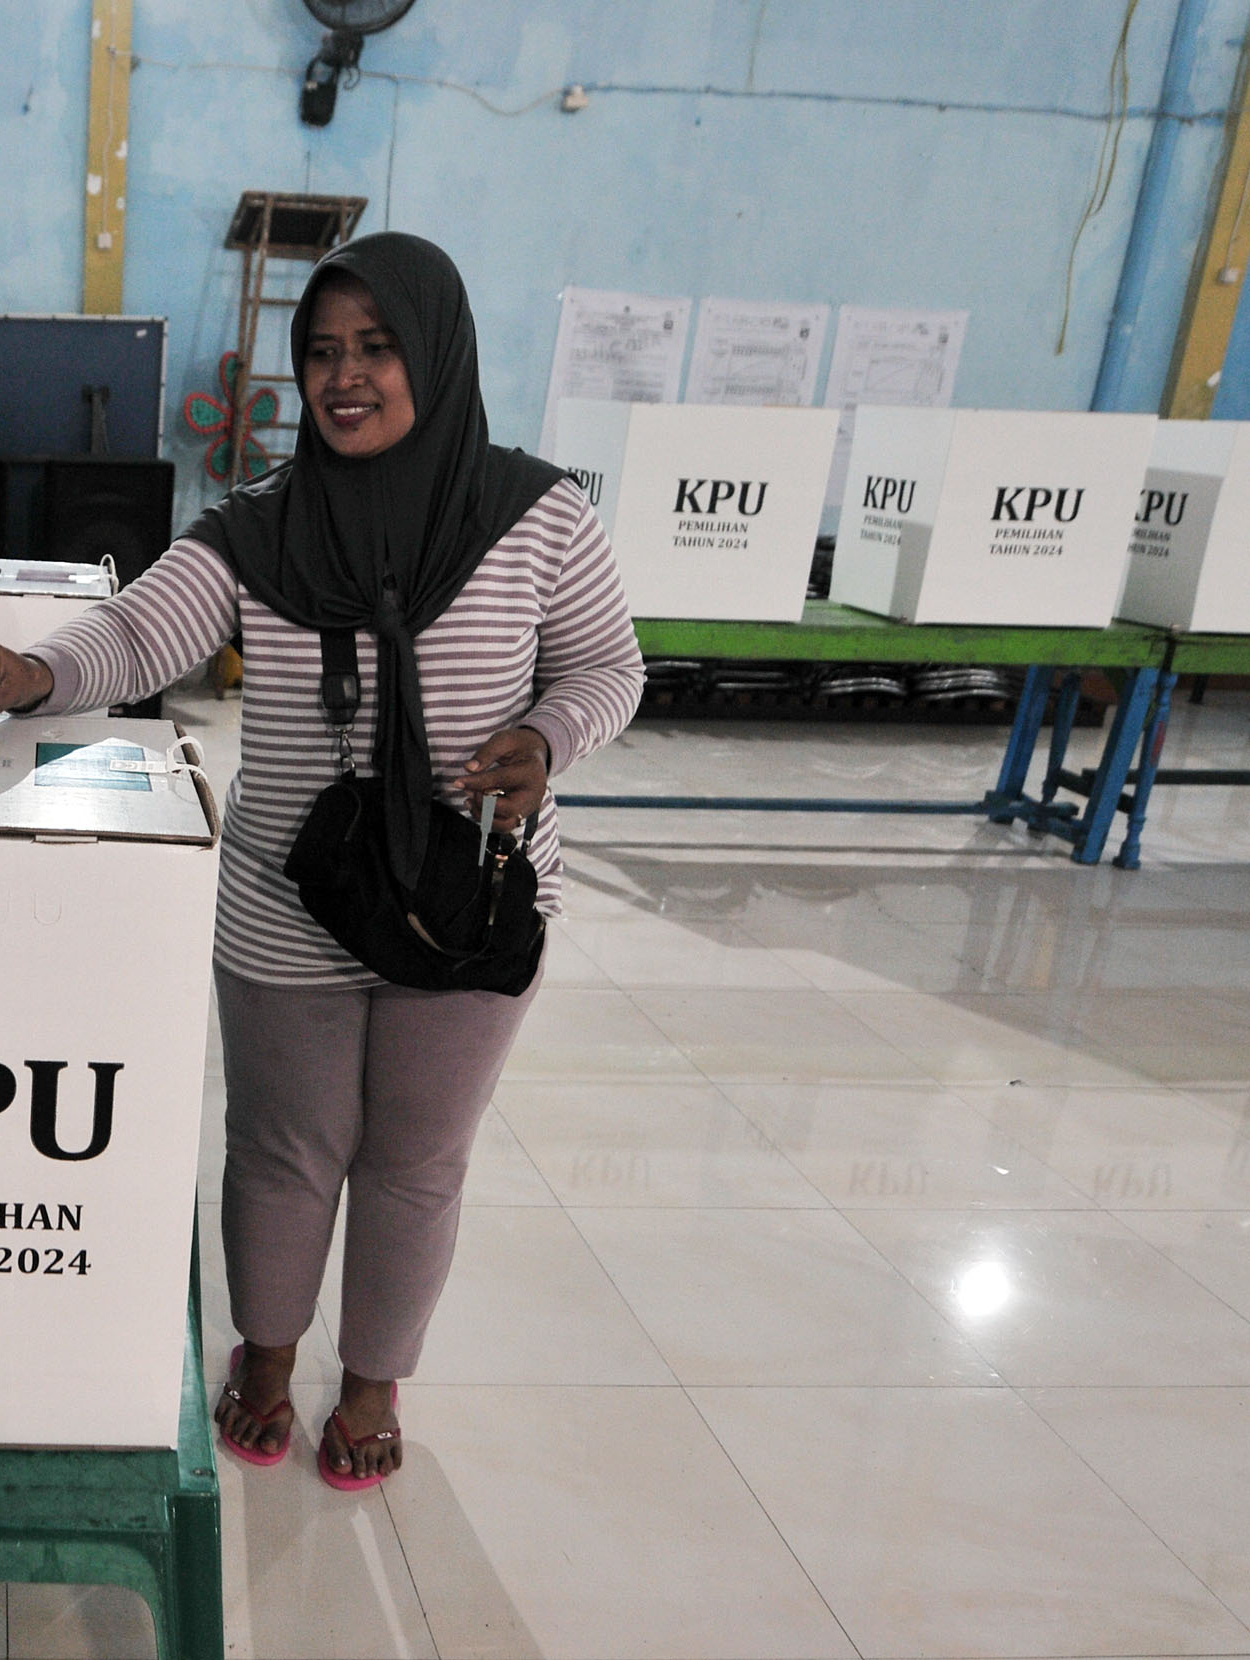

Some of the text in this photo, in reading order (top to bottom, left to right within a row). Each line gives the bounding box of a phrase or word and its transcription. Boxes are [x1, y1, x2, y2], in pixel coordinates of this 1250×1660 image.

[673, 478, 769, 516] KPU
[862, 475, 916, 514] KPU
[990, 486, 1086, 522] KPU
[678, 520, 749, 533] PEMILIHAN
[994, 528, 1064, 540] PEMILIHAN
[672, 536, 749, 550] TAHUN 2024
[988, 543, 1064, 556] TAHUN 2024
